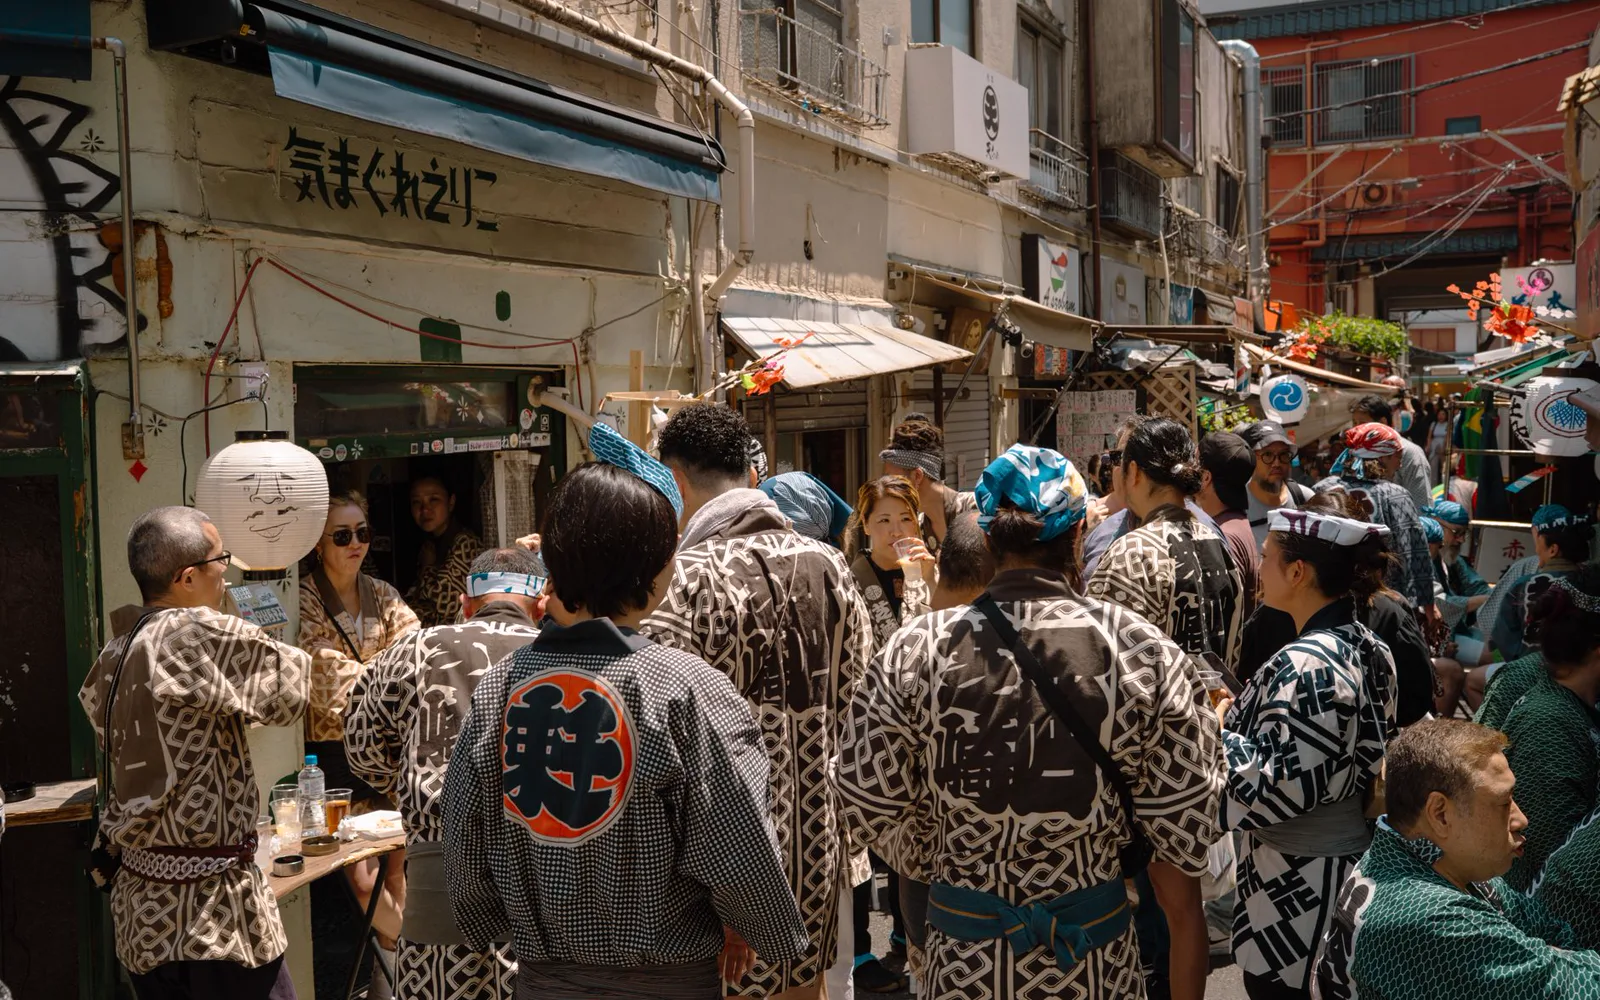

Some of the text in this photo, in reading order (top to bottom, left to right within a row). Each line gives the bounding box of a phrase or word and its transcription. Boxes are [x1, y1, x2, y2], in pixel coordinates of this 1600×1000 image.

[284, 126, 499, 232] 気まぐれえりこ
